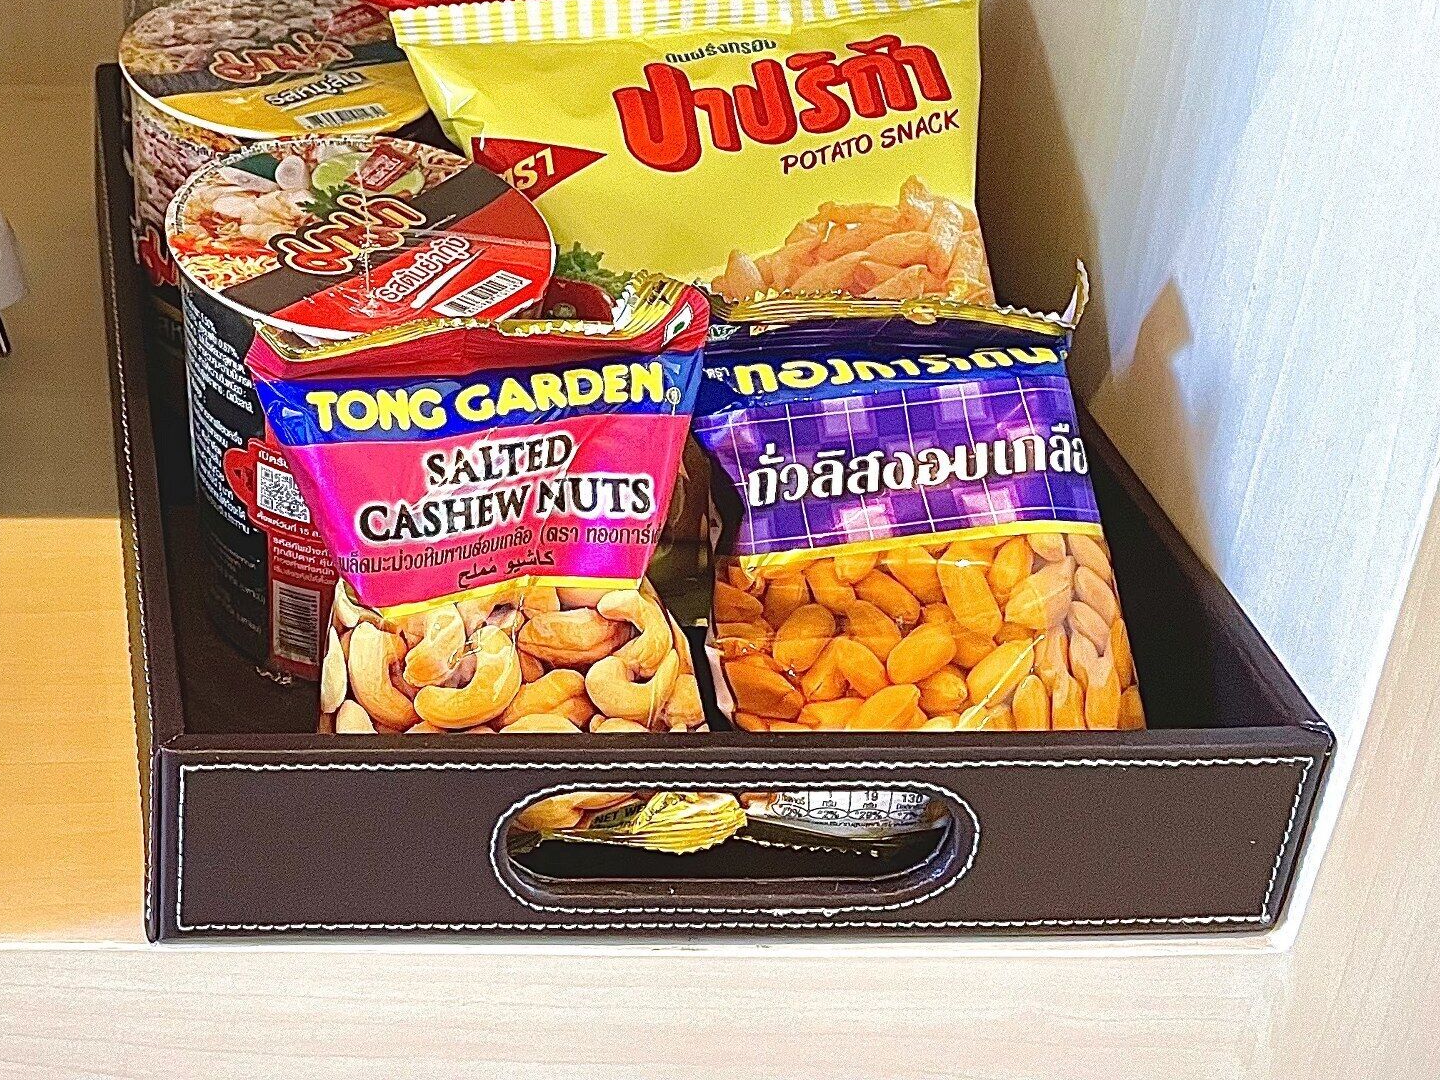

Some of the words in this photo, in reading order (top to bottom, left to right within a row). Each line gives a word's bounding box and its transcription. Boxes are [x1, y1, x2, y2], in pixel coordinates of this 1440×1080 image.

[780, 133, 874, 175] POTATO
[880, 108, 961, 150] SNACK
[306, 386, 448, 433] TONG
[454, 361, 664, 422] GARDEN
[425, 433, 573, 487] SALTED
[747, 422, 1090, 508] ถั่วลิสงอบเกลือ
[359, 483, 533, 544] CASHEW
[535, 473, 654, 516] NUTS
[539, 523, 580, 548] (ตรา
